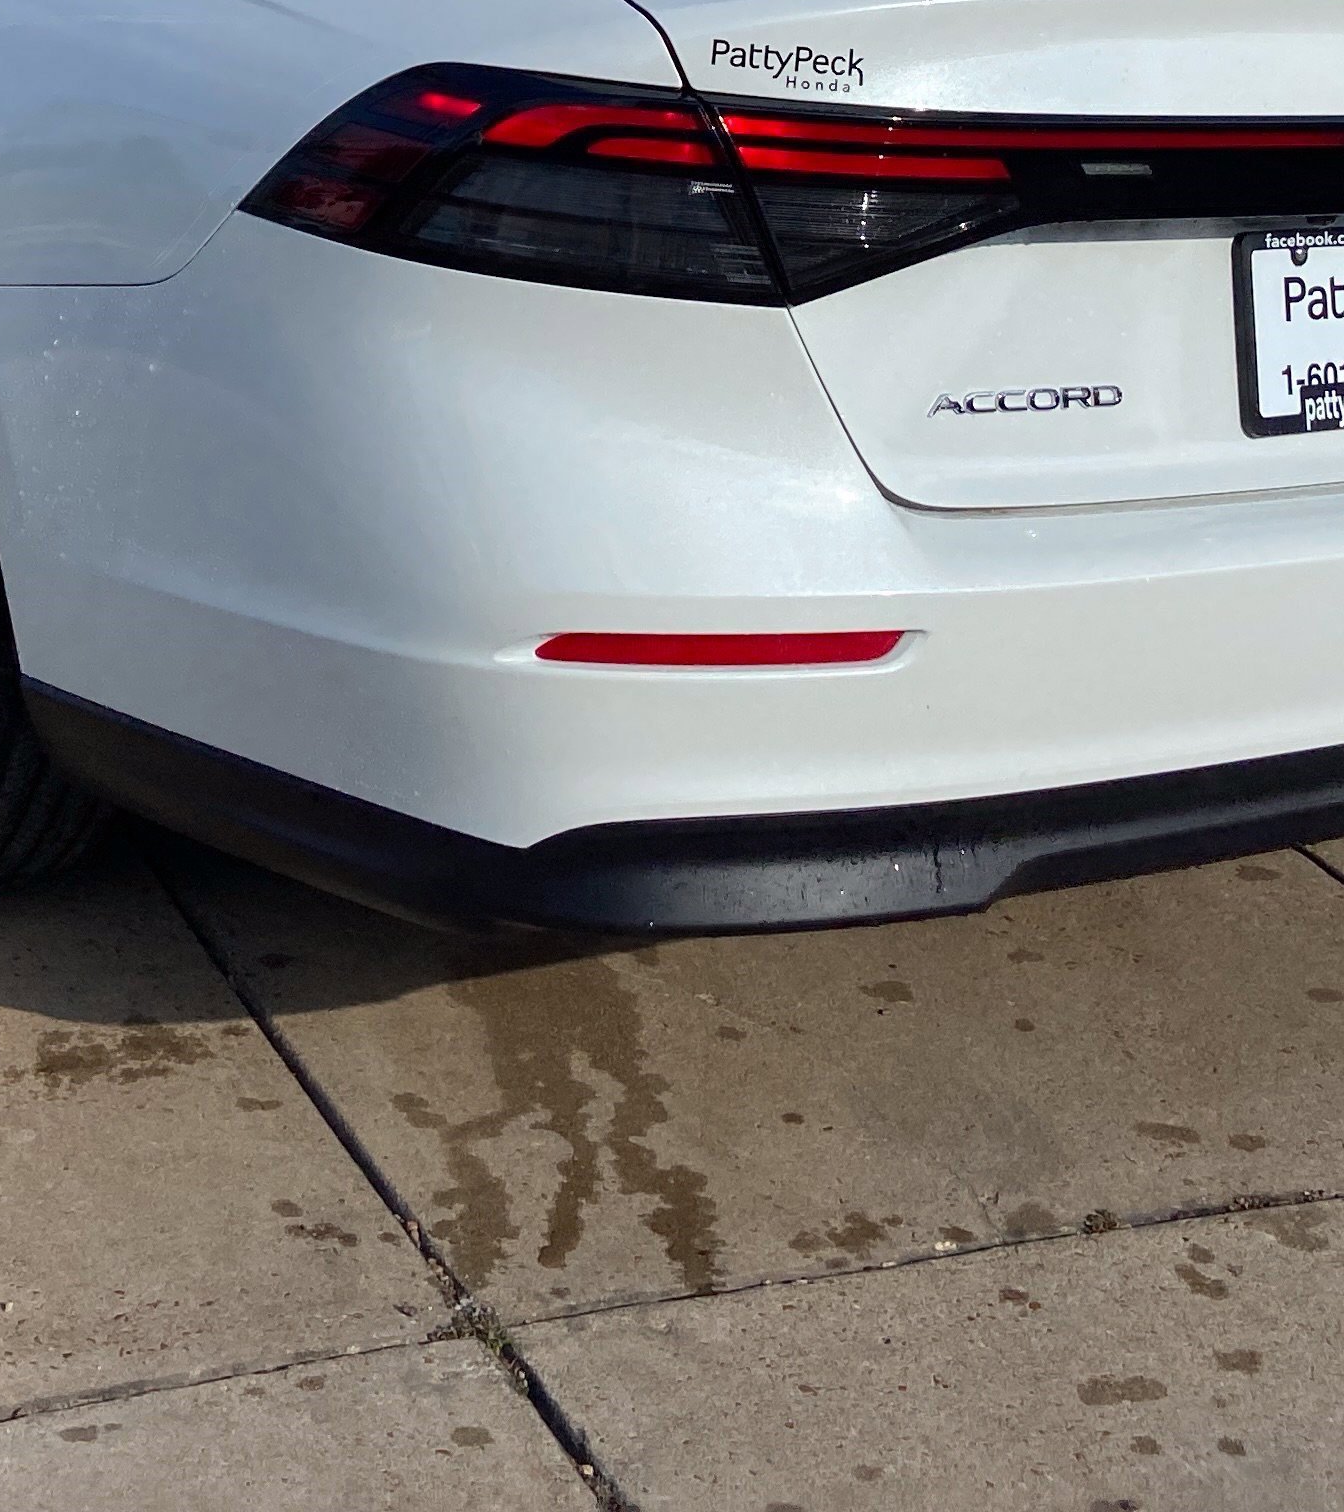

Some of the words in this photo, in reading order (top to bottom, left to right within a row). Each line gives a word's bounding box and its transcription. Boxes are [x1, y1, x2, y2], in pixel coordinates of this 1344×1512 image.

[711, 38, 864, 86] PattyPeck
[785, 75, 850, 93] Honda
[926, 385, 1123, 418] ACCORD
